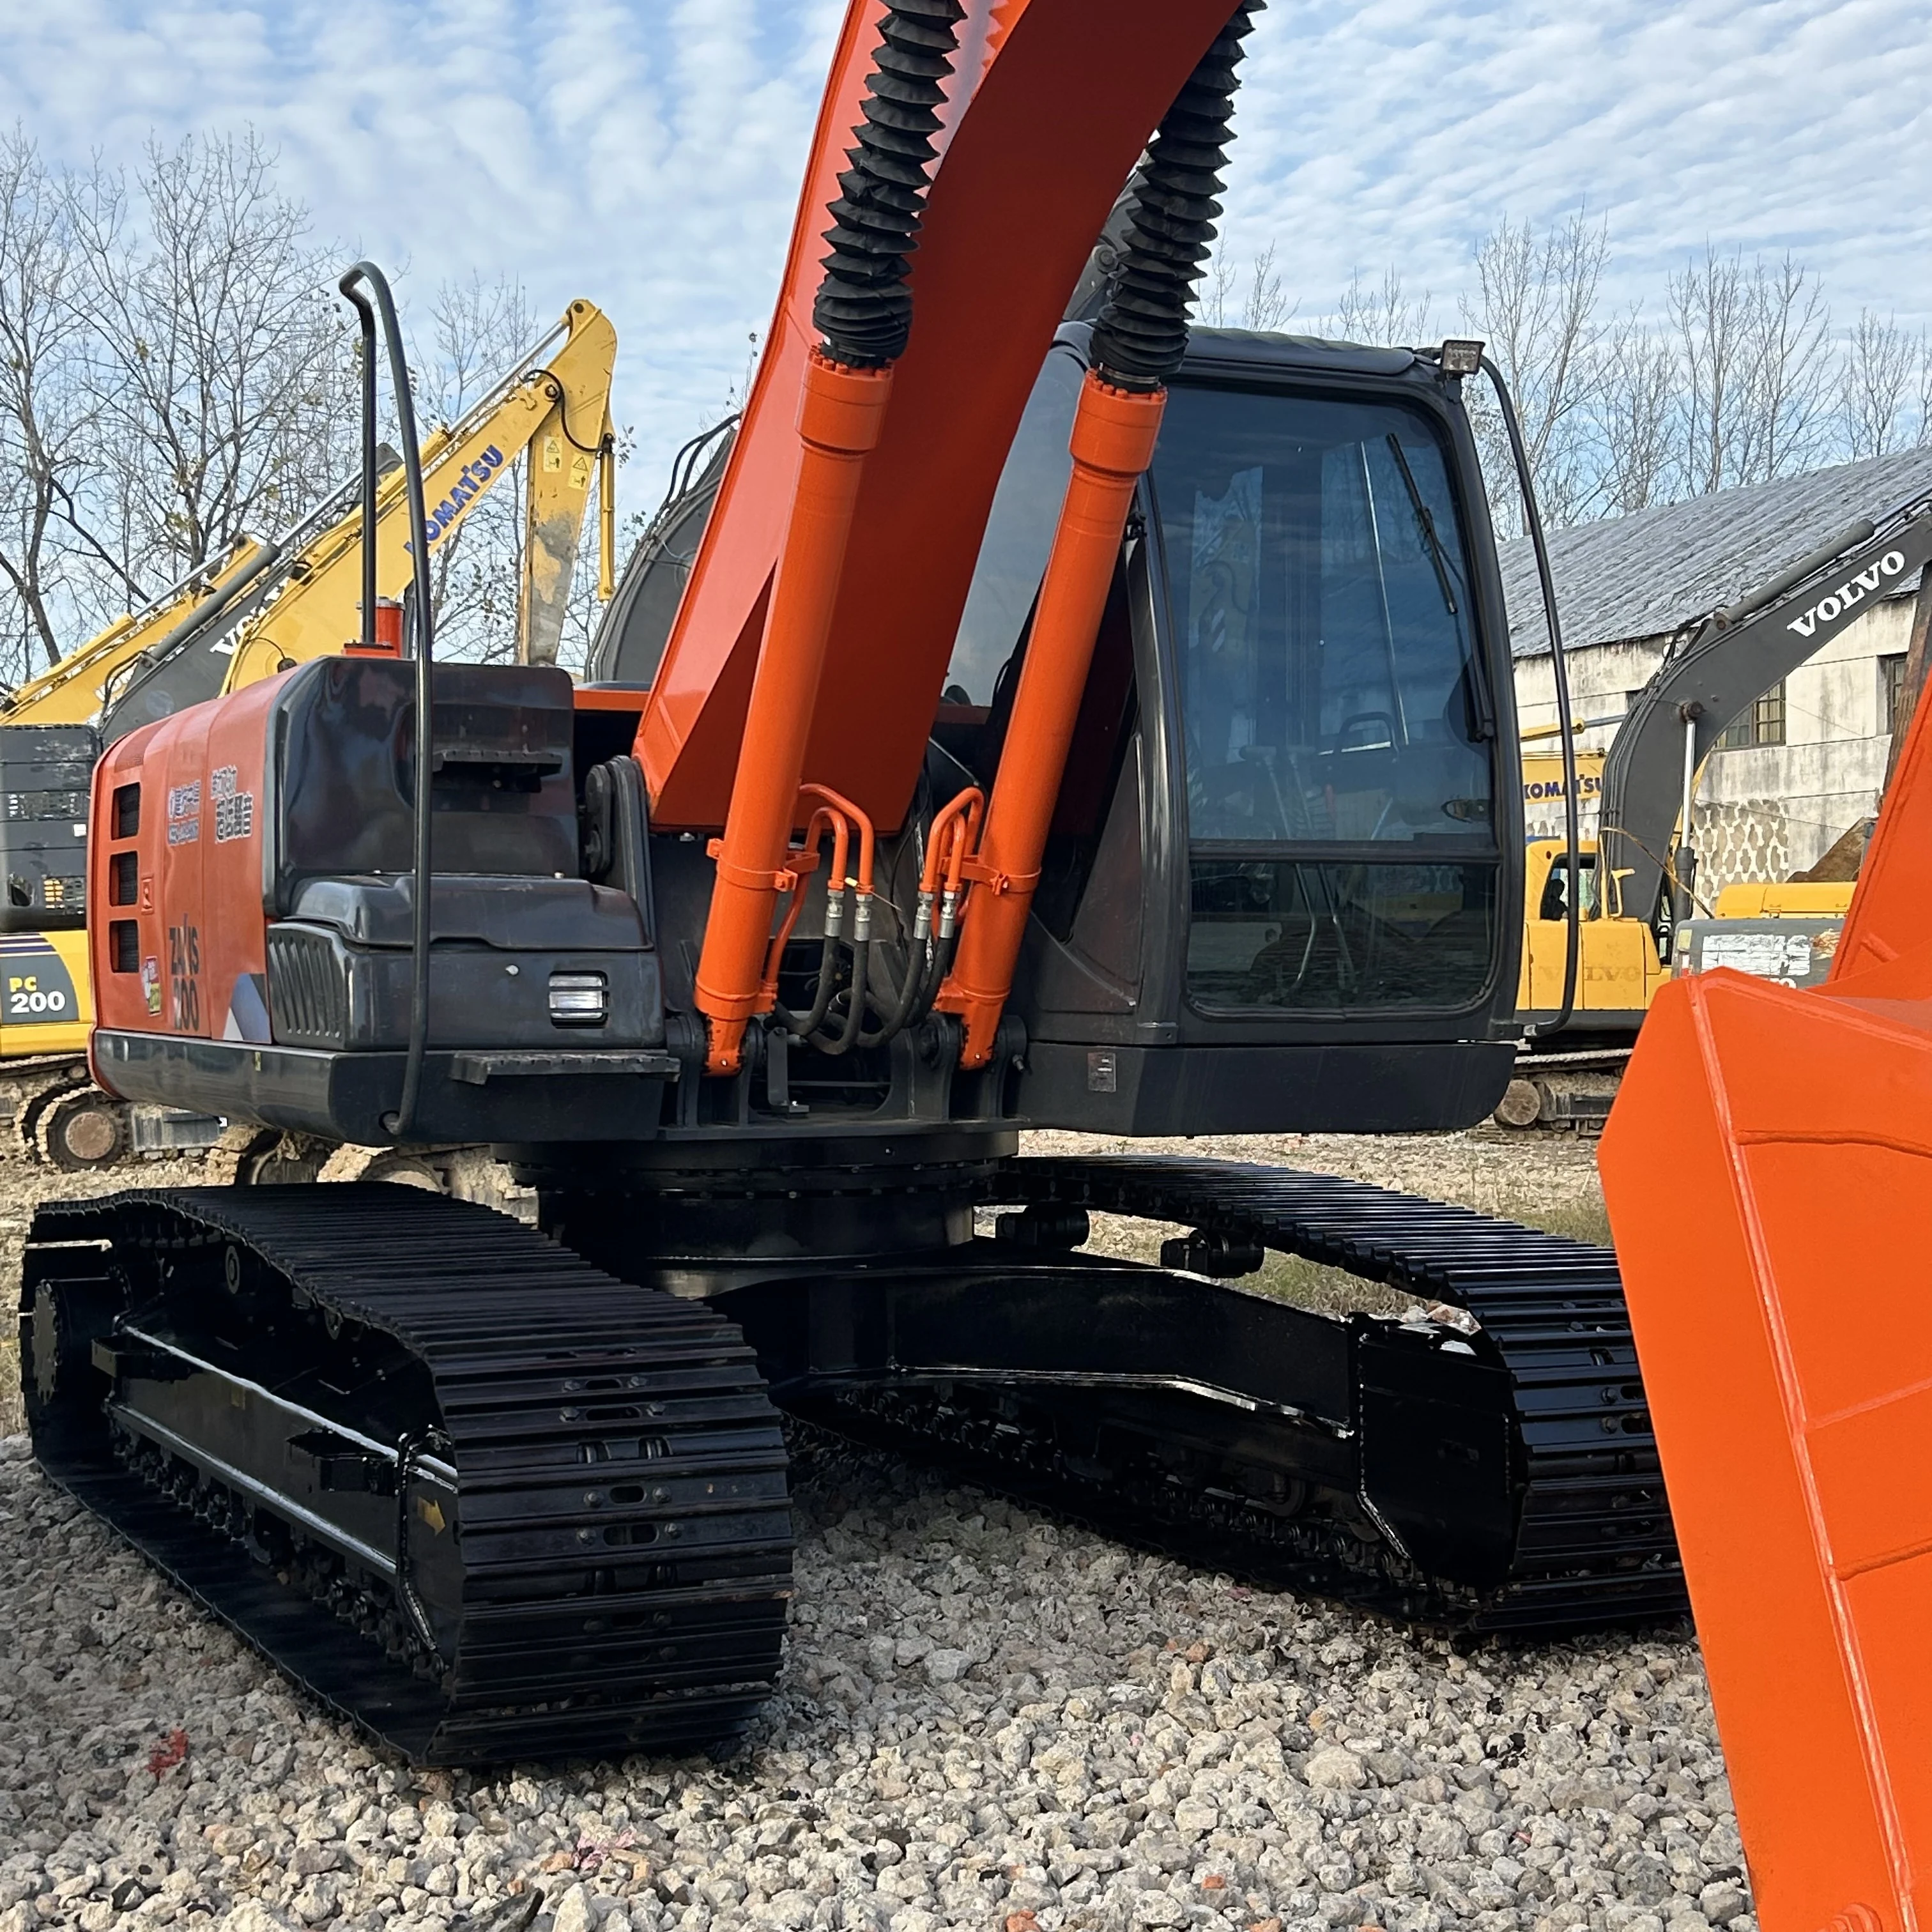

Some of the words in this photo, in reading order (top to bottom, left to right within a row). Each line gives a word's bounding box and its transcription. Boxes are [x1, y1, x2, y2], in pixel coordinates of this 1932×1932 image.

[403, 444, 503, 556] OMATSU
[1786, 550, 1905, 637] VOLVO
[9, 976, 37, 993] PC
[1538, 965, 1642, 982] VLVO
[10, 990, 66, 1014] 200
